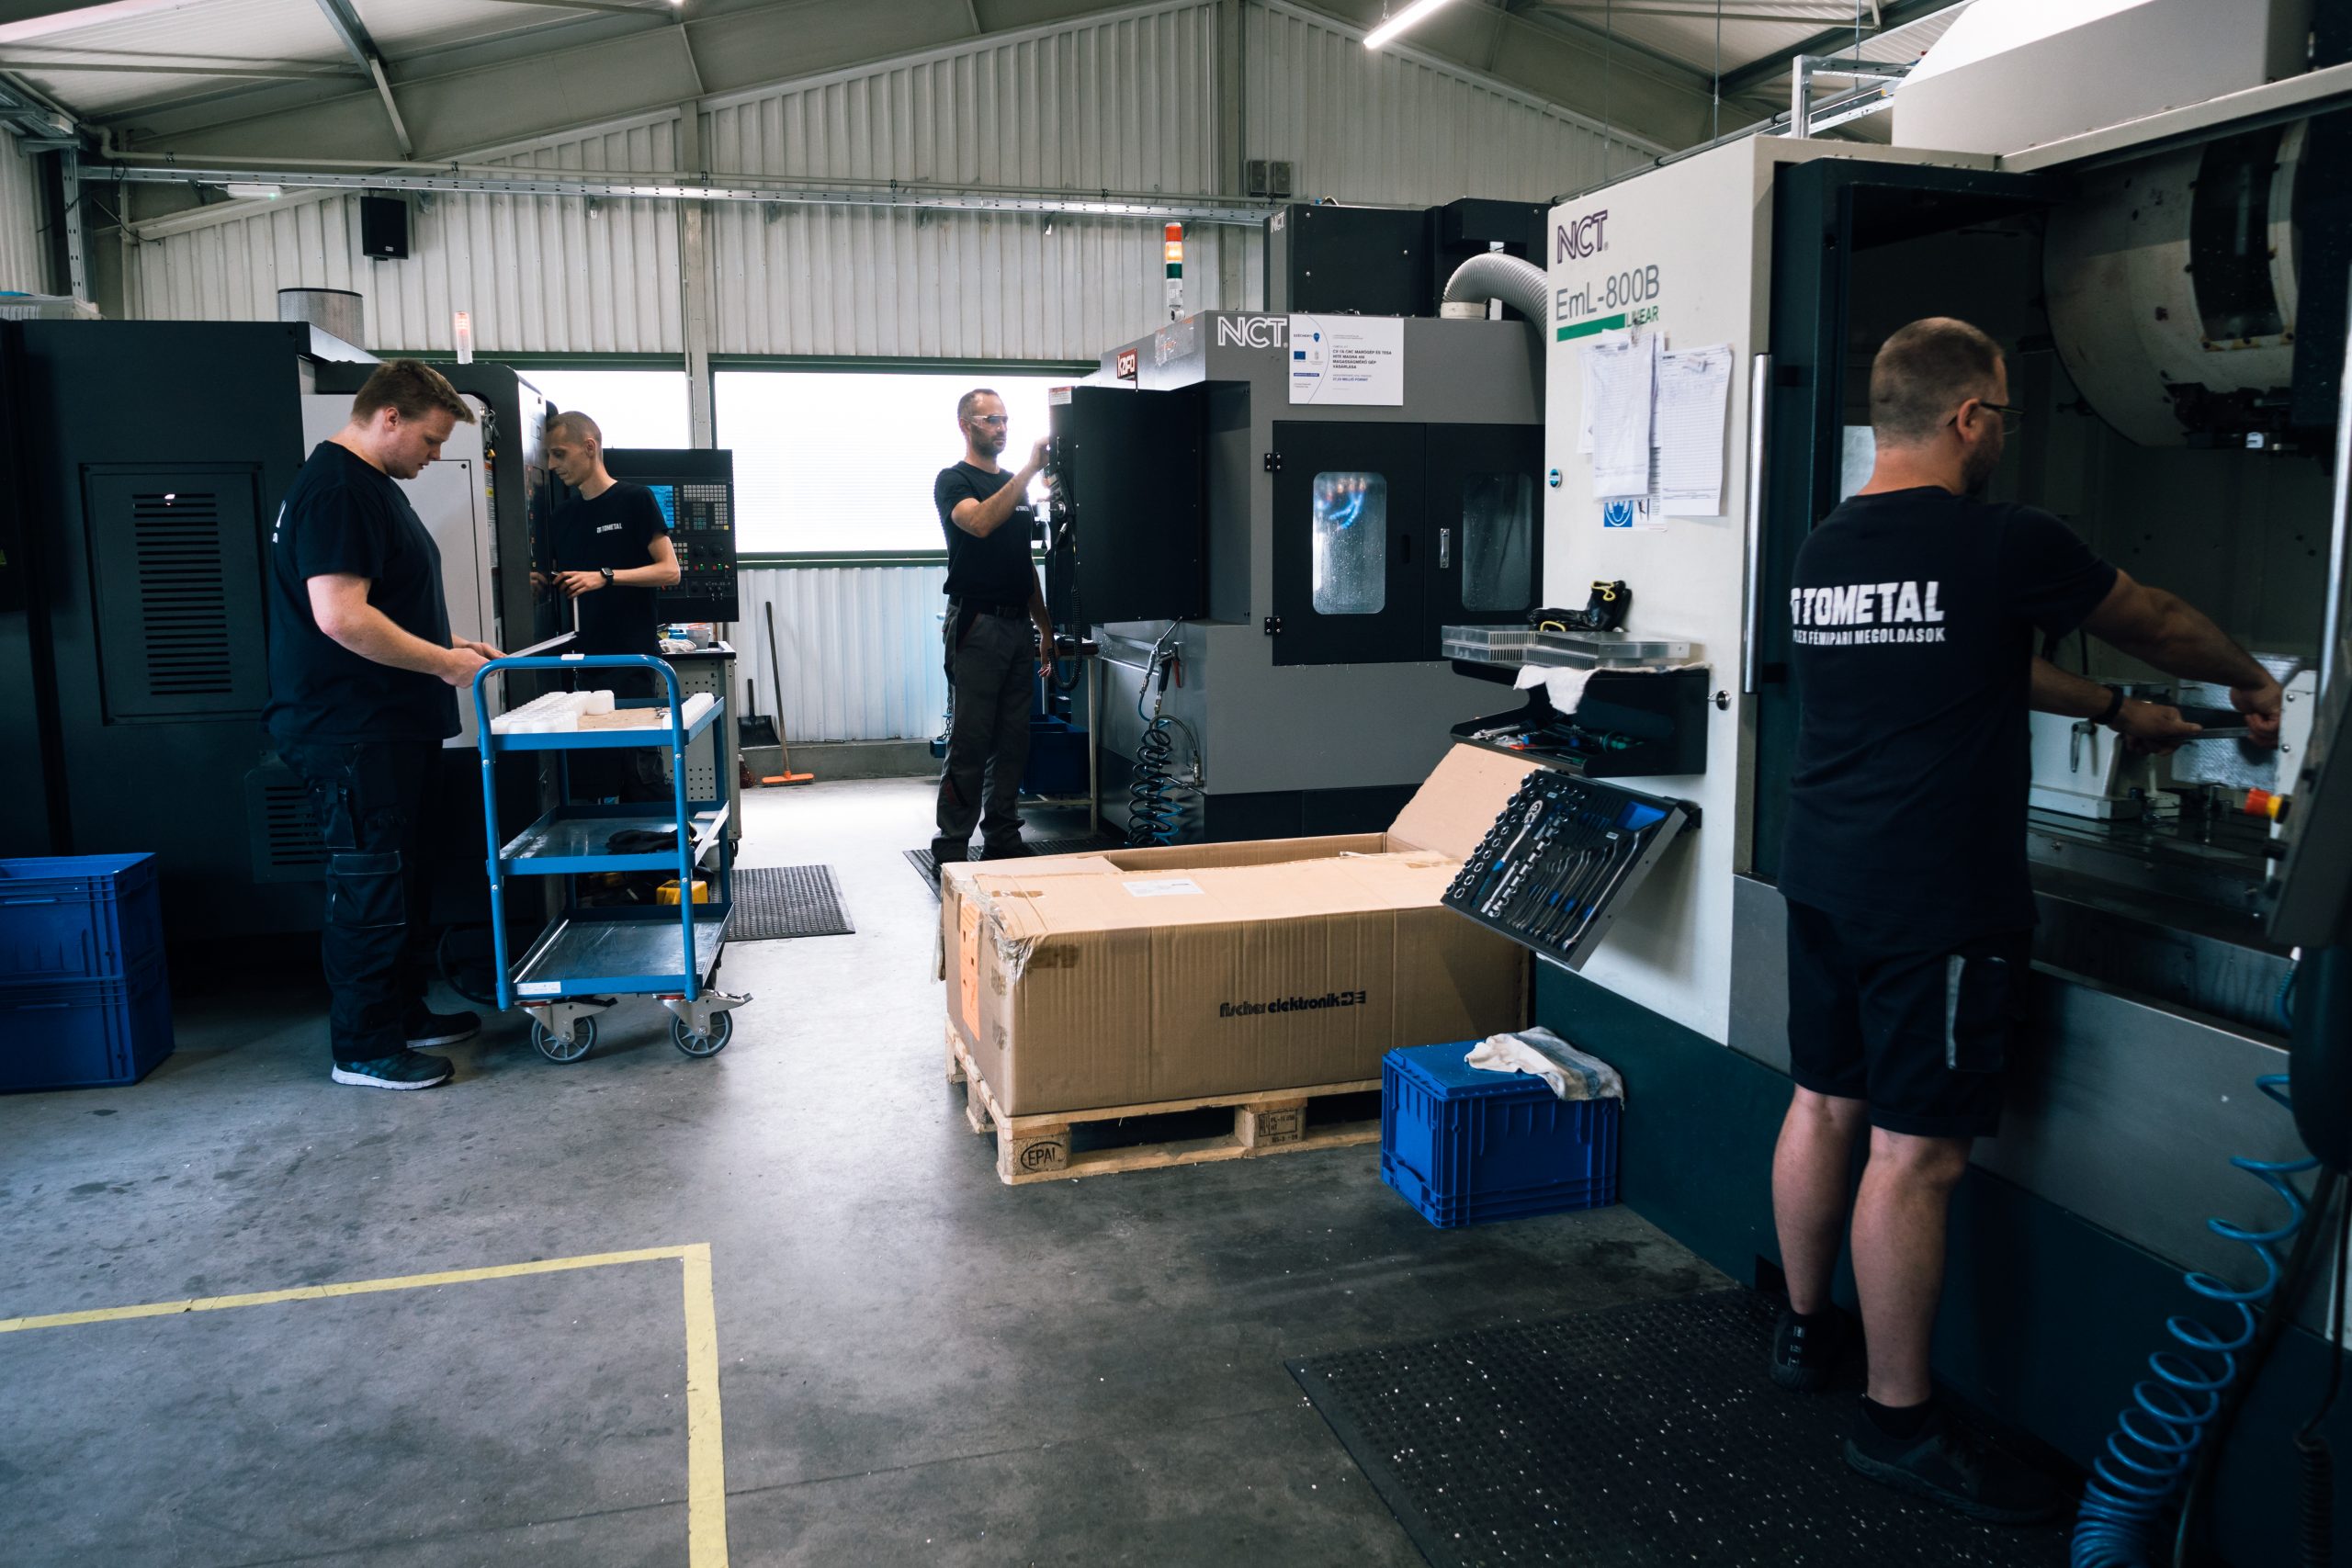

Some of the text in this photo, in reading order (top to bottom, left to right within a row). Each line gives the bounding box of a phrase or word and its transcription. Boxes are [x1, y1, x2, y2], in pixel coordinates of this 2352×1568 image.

[1556, 209, 1608, 265] NCT
[1556, 265, 1660, 321] EmL-800B
[1217, 316, 1288, 348] NCT
[1854, 626, 1946, 645] MEGOLDÁSOK
[1267, 993, 1340, 1014] elektronik
